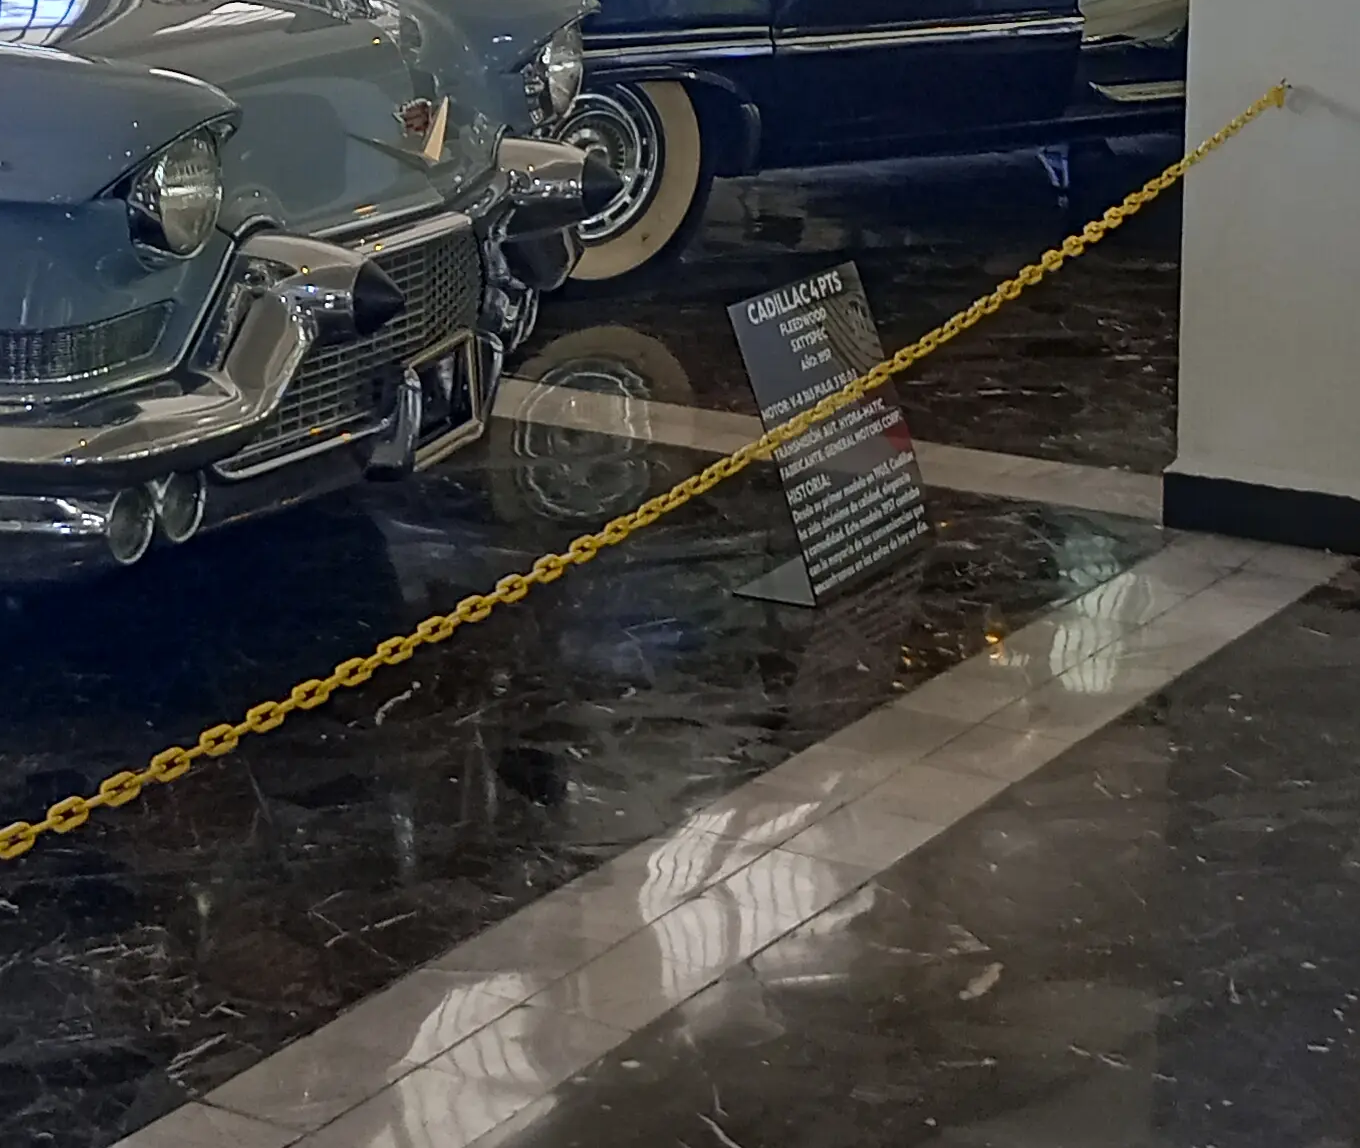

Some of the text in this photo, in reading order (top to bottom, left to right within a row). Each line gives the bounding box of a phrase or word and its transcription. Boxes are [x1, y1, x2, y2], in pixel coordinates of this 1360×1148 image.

[747, 271, 843, 325] CADILLAC 4 PTS
